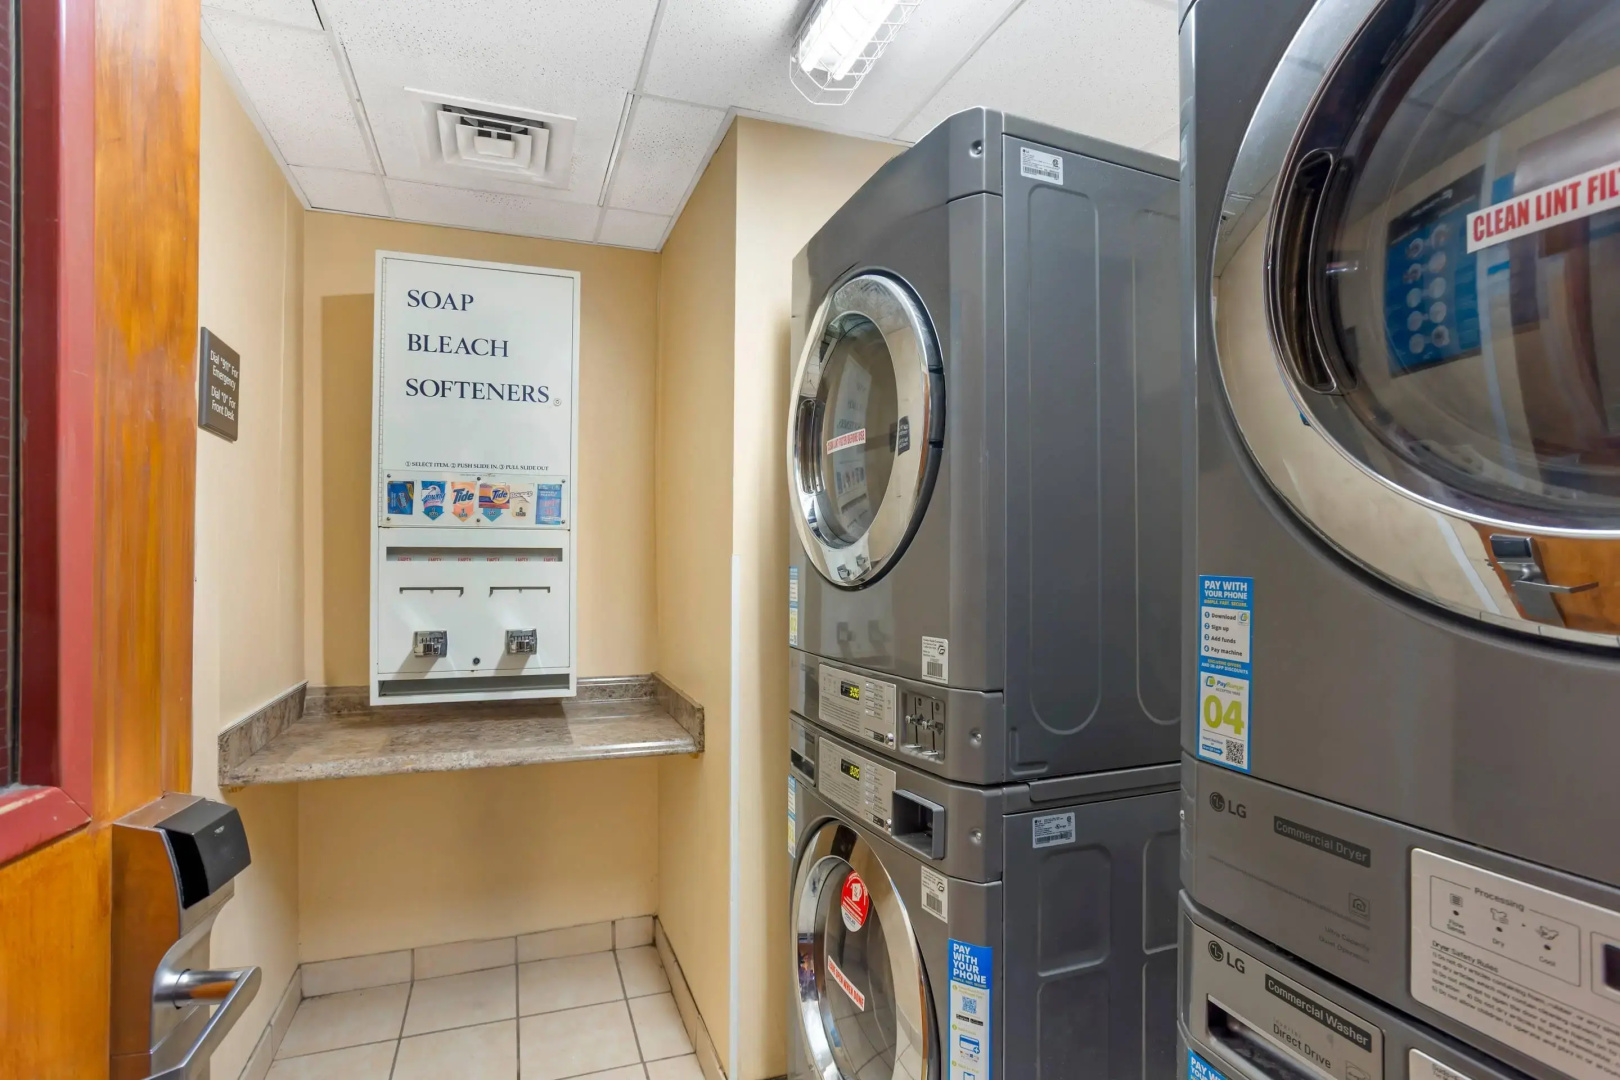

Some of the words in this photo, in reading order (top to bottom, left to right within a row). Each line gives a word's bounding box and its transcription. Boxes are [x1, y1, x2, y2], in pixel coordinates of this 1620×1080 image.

[1473, 199, 1529, 242] CLEAN
[1536, 181, 1582, 222] LINT
[407, 289, 474, 311] SOAP
[407, 333, 509, 357] BLEACH
[210, 349, 220, 365] Dial
[212, 365, 236, 391] Emergency
[211, 386, 220, 400] Dial
[405, 378, 550, 403] SOFTENERS
[212, 400, 224, 415] Front
[225, 406, 234, 421] Desk
[453, 488, 474, 504] Tide
[492, 490, 507, 500] Tide
[1204, 580, 1221, 590] PAY
[1223, 581, 1247, 591] WITH
[1224, 591, 1247, 600] PHONE
[1221, 648, 1242, 656] machine
[1204, 694, 1244, 735] 04
[1228, 800, 1246, 819] LG
[1276, 820, 1333, 850] Commercial
[1336, 842, 1367, 862] Dryer
[1474, 888, 1524, 912] Processing
[954, 943, 970, 954] PAY
[1492, 937, 1505, 948] Dry
[953, 951, 978, 965] WITH
[1226, 952, 1245, 974] LG
[1432, 940, 1449, 952] Dryer
[1451, 948, 1475, 963] Safety
[1477, 959, 1498, 973] Rules
[1539, 956, 1556, 967] Cool
[953, 960, 979, 974] YOUR
[954, 968, 986, 984] PHONE
[1268, 979, 1323, 1021] Commercial
[1326, 1012, 1369, 1046] Washer
[1273, 1023, 1301, 1050] Direct
[1304, 1044, 1331, 1069] Drive
[1191, 1056, 1207, 1074] PAY
